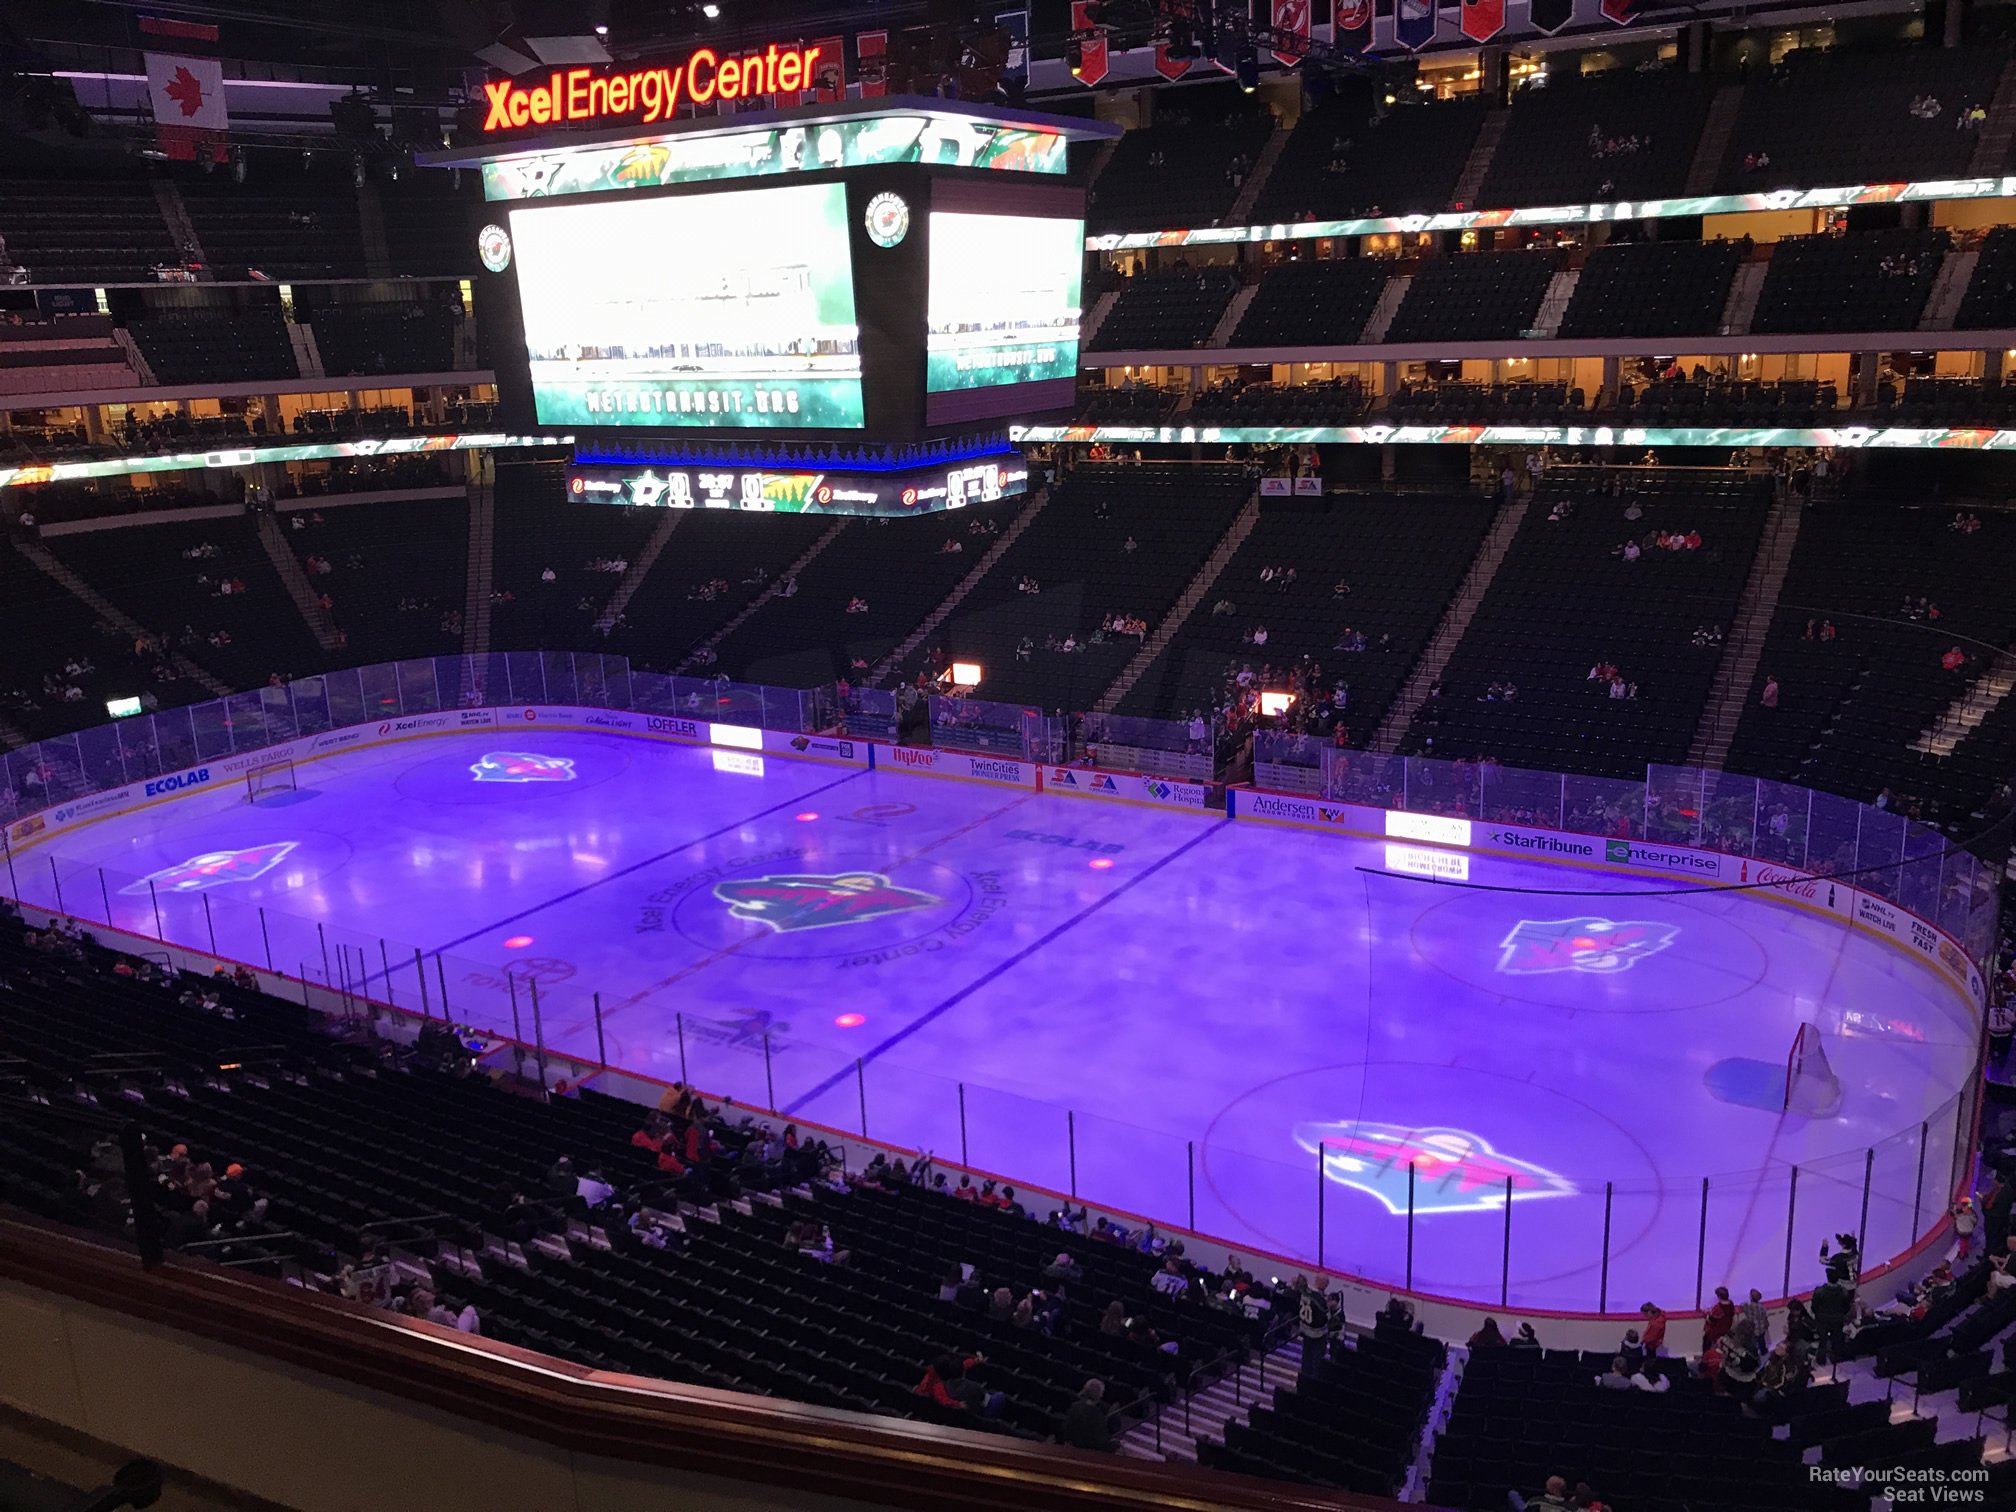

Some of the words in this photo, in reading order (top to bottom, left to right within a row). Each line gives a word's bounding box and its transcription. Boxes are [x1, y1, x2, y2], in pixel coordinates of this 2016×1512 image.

[484, 73, 562, 130] Xcel
[568, 66, 682, 123] Energy
[687, 44, 820, 102] Center
[395, 720, 416, 731] Xcel
[646, 717, 696, 734] LOFFLER
[223, 758, 259, 773] WELLS
[260, 748, 295, 762] FARGO
[145, 768, 210, 797] ECOLAB
[1254, 795, 1314, 815] Andersen
[1503, 832, 1593, 856] StarTribune
[1613, 845, 1717, 870] enterprise
[1859, 909, 1881, 925] WATCH
[1882, 920, 1896, 932] LIVE
[1911, 921, 1938, 943] FRESH
[1913, 936, 1934, 954] FAST
